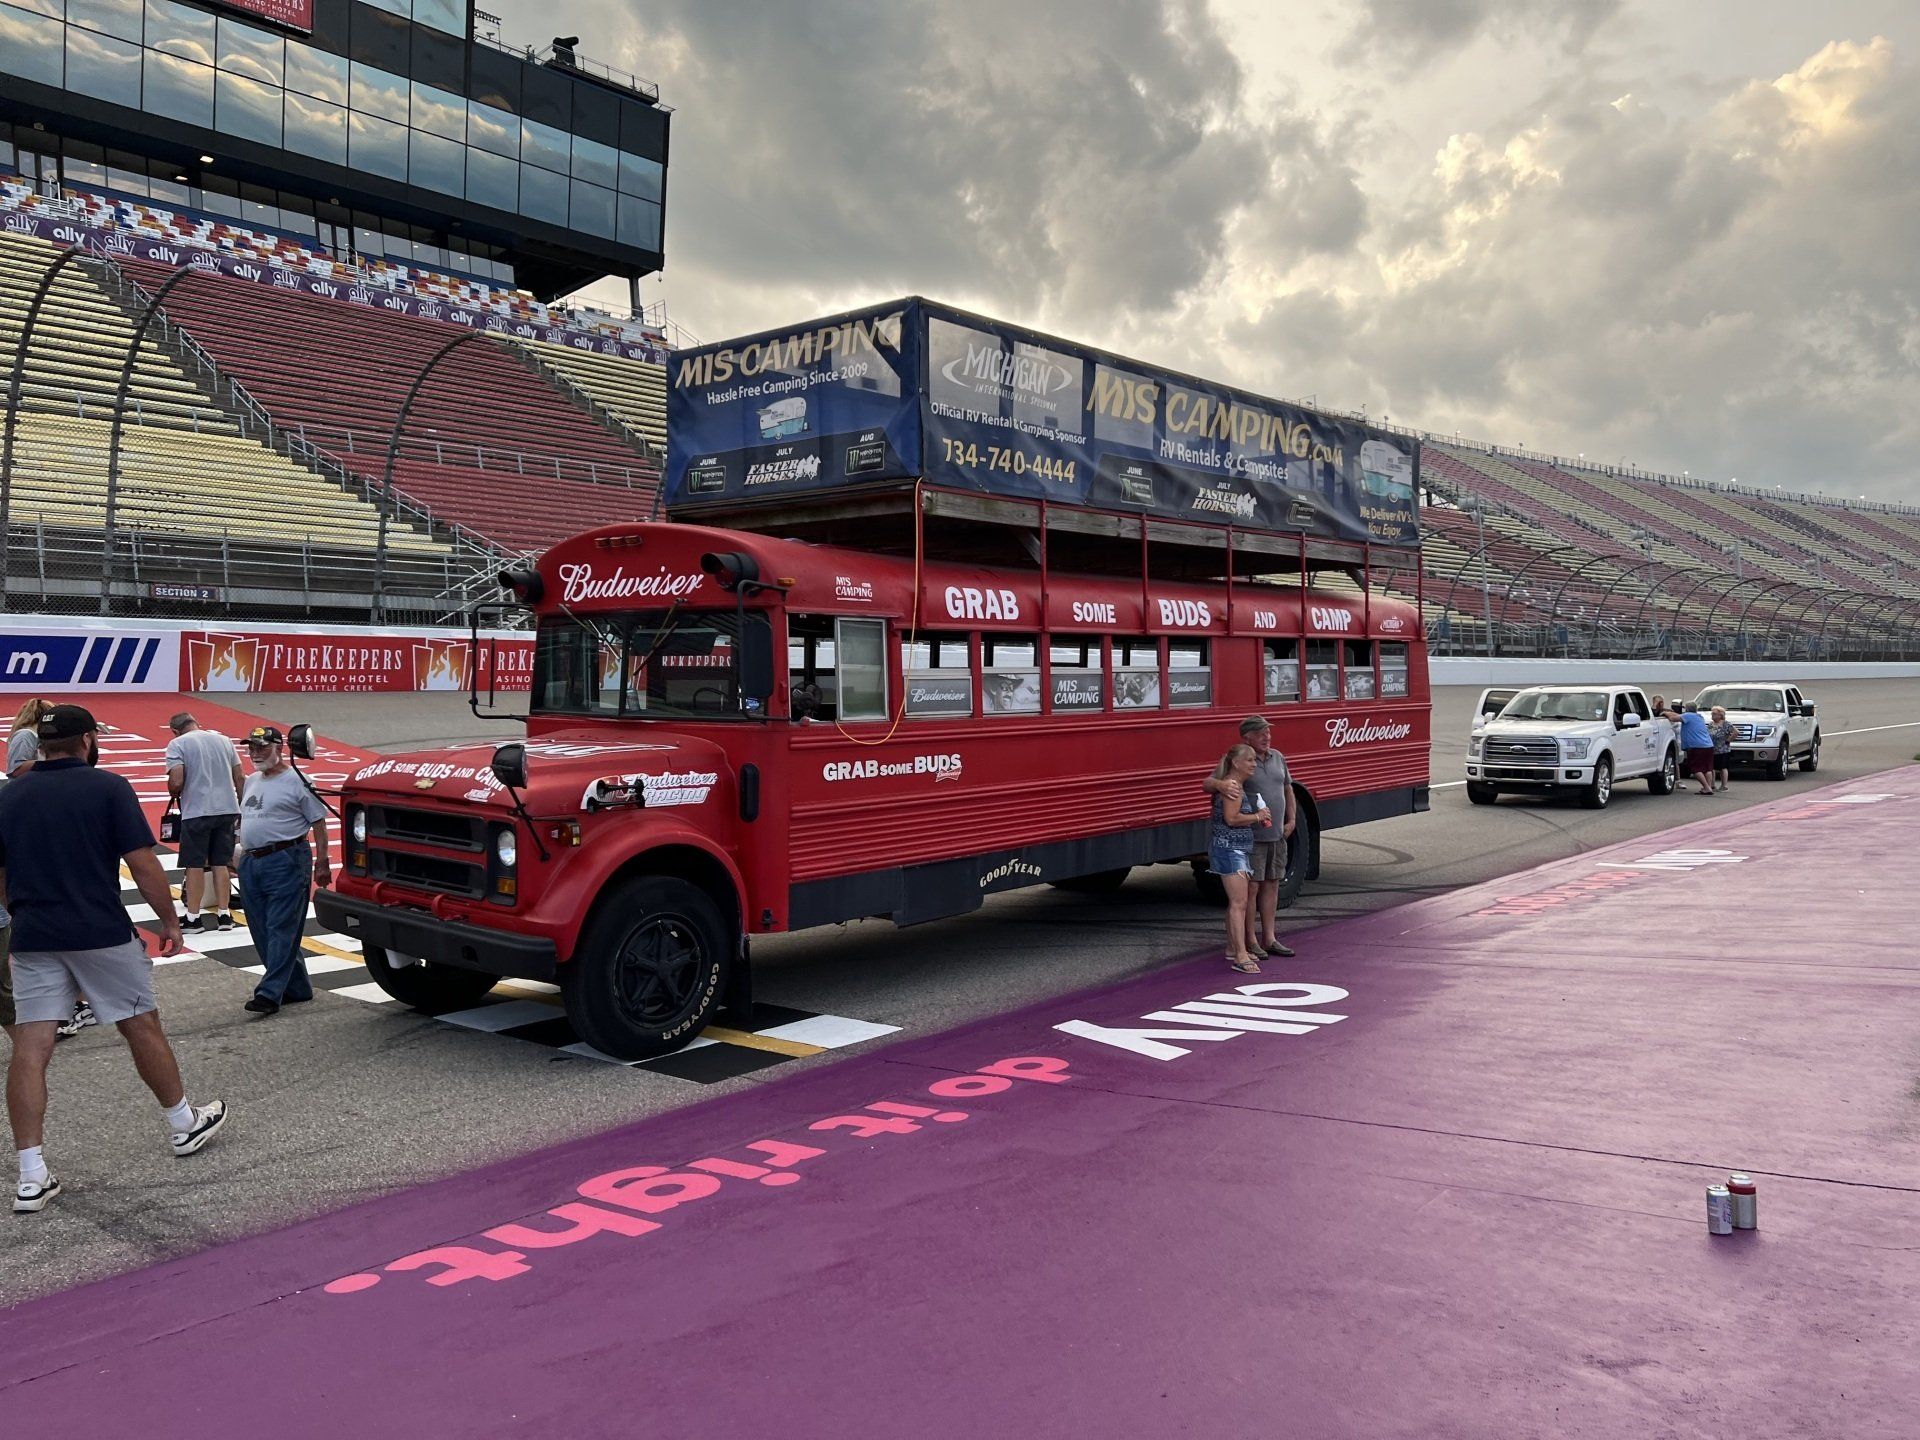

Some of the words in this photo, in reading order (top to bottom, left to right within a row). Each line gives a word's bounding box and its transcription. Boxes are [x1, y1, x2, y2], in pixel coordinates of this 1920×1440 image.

[53, 226, 86, 243] ally
[148, 246, 179, 265] ally
[233, 264, 261, 282] ally
[311, 281, 338, 299] ally
[384, 297, 409, 313] ally
[451, 311, 473, 326] ally
[516, 325, 537, 340] ally
[574, 337, 593, 350] ally
[675, 348, 733, 389] MIS
[740, 311, 904, 377] CAMPING
[628, 348, 647, 362] ally
[963, 343, 1053, 396] MICHIGAN
[707, 386, 738, 405] Hassle
[738, 380, 761, 399] Free
[762, 374, 808, 396] Camping
[809, 368, 839, 387] Since
[841, 362, 868, 380] 2009
[1086, 368, 1160, 424] MIS
[931, 402, 964, 420] Official
[966, 410, 980, 423] RV
[982, 414, 1012, 428] Rental
[1055, 429, 1087, 445] Sponsor
[860, 433, 875, 443] AUG
[776, 447, 794, 457] JULY
[1160, 438, 1174, 459] RV
[1177, 443, 1221, 468] Rentals
[1223, 451, 1233, 469] &
[1236, 454, 1289, 481] Campsites
[700, 457, 717, 466] JUNE
[749, 459, 800, 475] FASTER
[942, 437, 1076, 484] 734-740-4444
[744, 470, 796, 486] HORSES
[1126, 466, 1142, 476] JUNE
[1216, 482, 1231, 490] JULY
[1197, 486, 1238, 503] FASTER
[1192, 498, 1237, 514] HORSES
[1360, 505, 1370, 519] We
[1371, 507, 1397, 520] Deliver
[1368, 522, 1381, 535] You
[559, 563, 704, 602] Budweiser
[835, 576, 851, 586] MIS
[155, 587, 197, 597] SECTION
[202, 590, 209, 598] 2
[835, 586, 873, 597] CAMPING
[944, 586, 1019, 620] GRAB
[1072, 601, 1116, 624] SOME
[1157, 599, 1211, 627] BUDS
[1254, 611, 1277, 629] AND
[1311, 607, 1352, 631] CAMP
[272, 644, 402, 670] FIREKEEPERS
[285, 674, 337, 683] CASINO
[349, 675, 389, 683] HOTEL
[1057, 680, 1078, 691] MIS
[301, 684, 337, 692] BATTLE
[343, 684, 374, 692] CREEK
[910, 688, 966, 703] Budweiser
[1170, 682, 1207, 695] Budweiser
[1054, 692, 1099, 705] CAMPING
[42, 714, 56, 722] CAT
[1325, 718, 1411, 749] Budweiser
[355, 760, 395, 781] GRAB
[393, 763, 418, 774] SOME
[415, 763, 456, 779] BUDS
[452, 768, 476, 778] AND
[822, 759, 879, 781] GRAB
[880, 762, 914, 777] SOME
[914, 753, 962, 774] BUDS
[979, 859, 1042, 888] GOODYEAR
[1053, 982, 1351, 1060] ally
[929, 1056, 1071, 1098] do
[809, 1101, 970, 1138] it
[323, 1139, 826, 1295] right.
